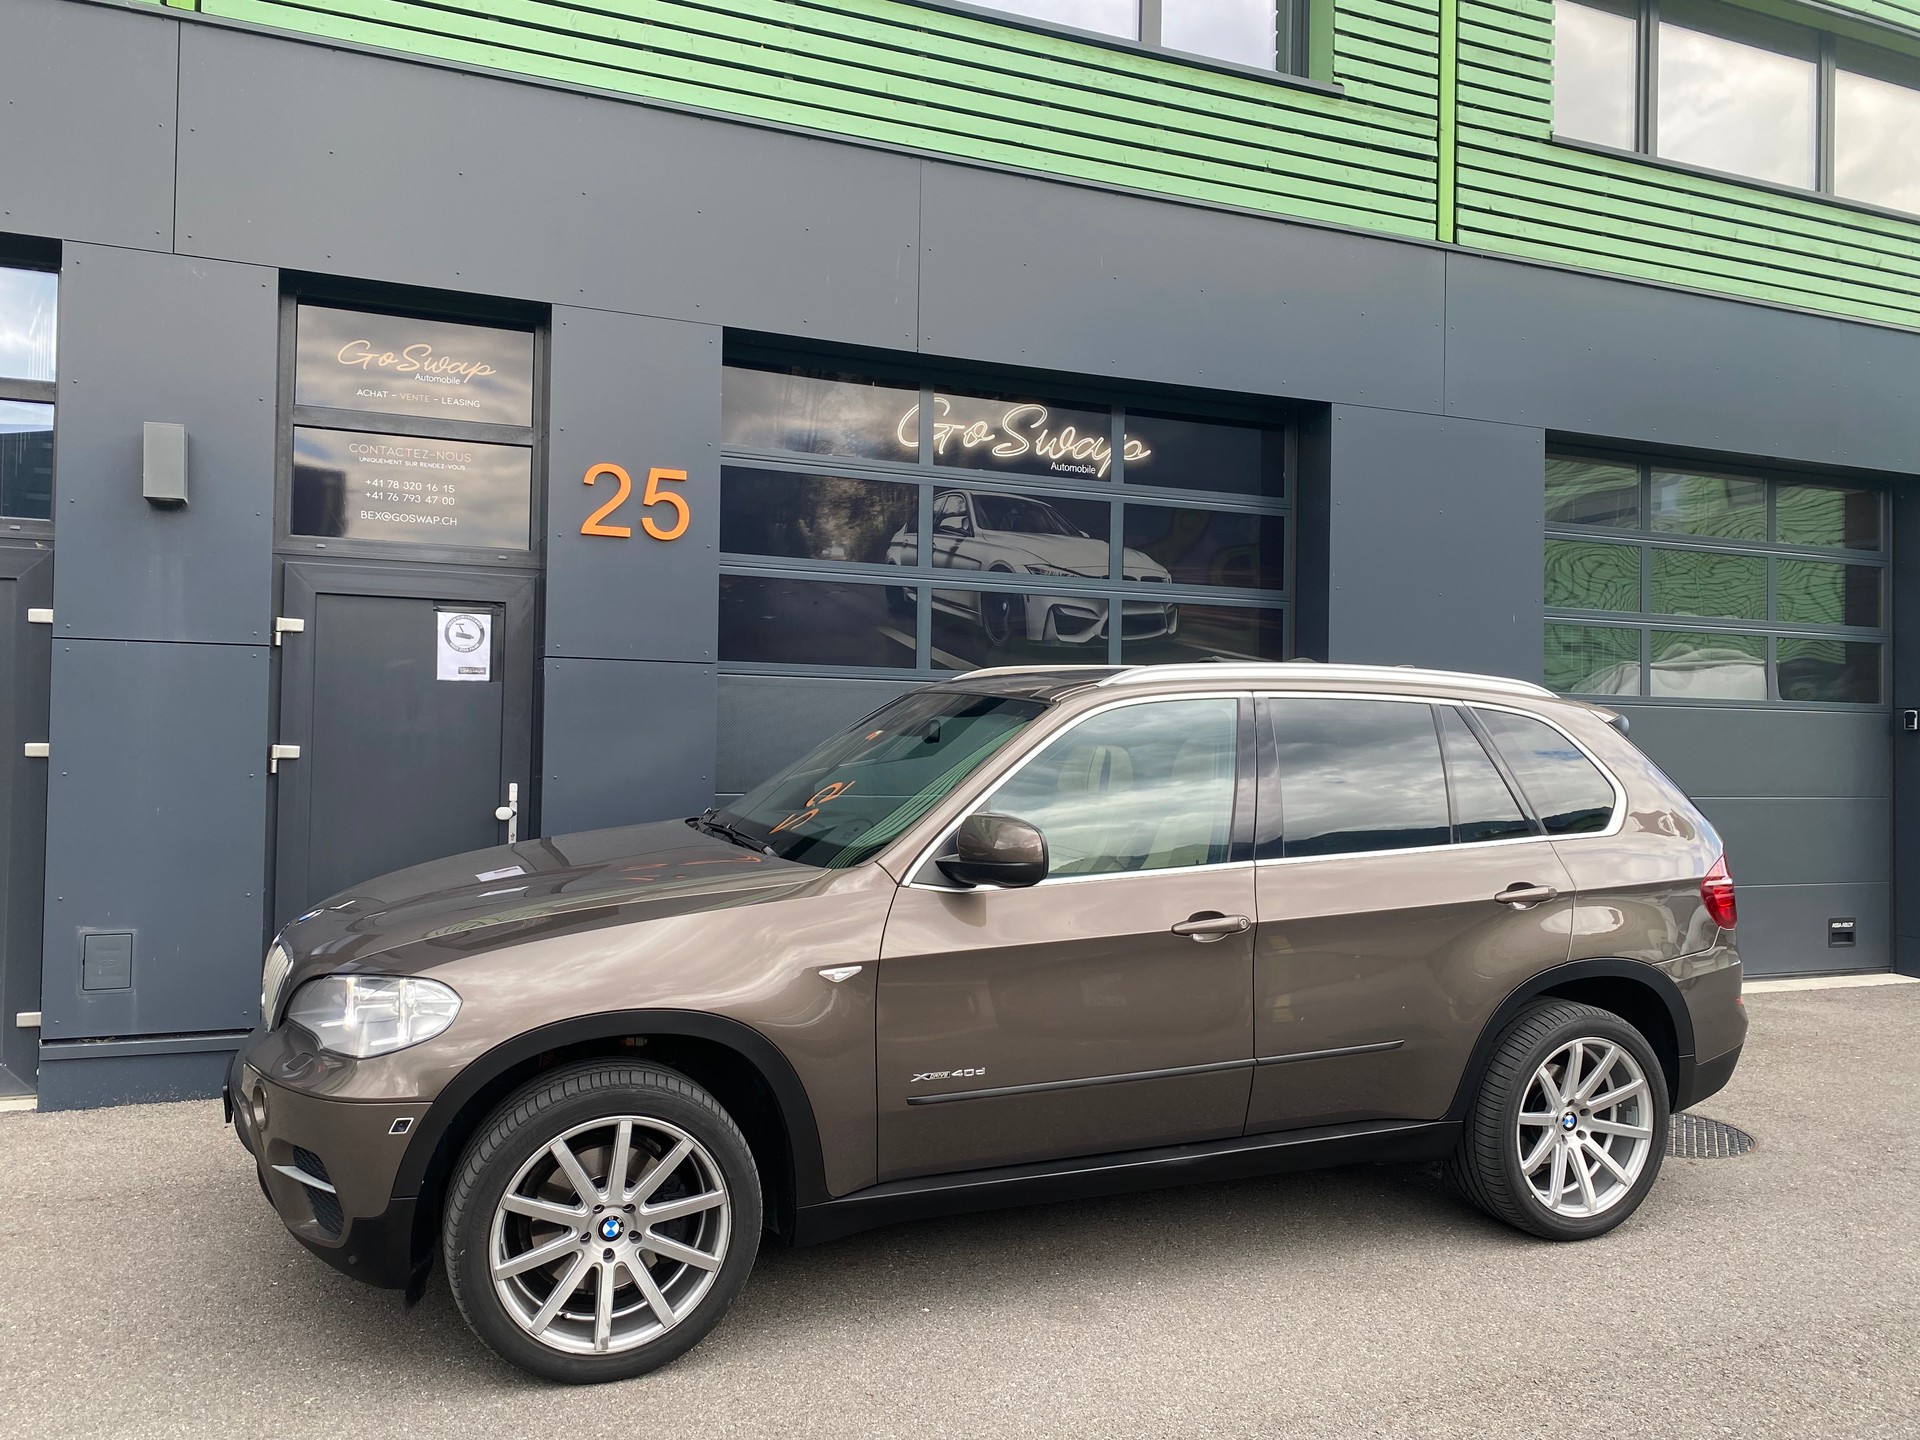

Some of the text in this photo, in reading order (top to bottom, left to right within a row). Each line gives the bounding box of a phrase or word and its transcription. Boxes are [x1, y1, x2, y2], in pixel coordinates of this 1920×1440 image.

[414, 373, 461, 385] Automobile
[356, 389, 389, 398] ACHAT
[400, 393, 430, 403] VENTE
[441, 396, 480, 408] LEASING
[349, 443, 472, 463] CONTACTEZ-NOUS
[359, 456, 466, 471] UNIQUEMENT SUR RENDEZ-VOUS
[1050, 461, 1096, 475] Automobile
[365, 479, 455, 493] +41 78 320 16 15
[365, 491, 455, 506] +41 76 793 47 00
[580, 463, 690, 541] 25
[360, 511, 457, 526] BEX@GOSWAP.CH
